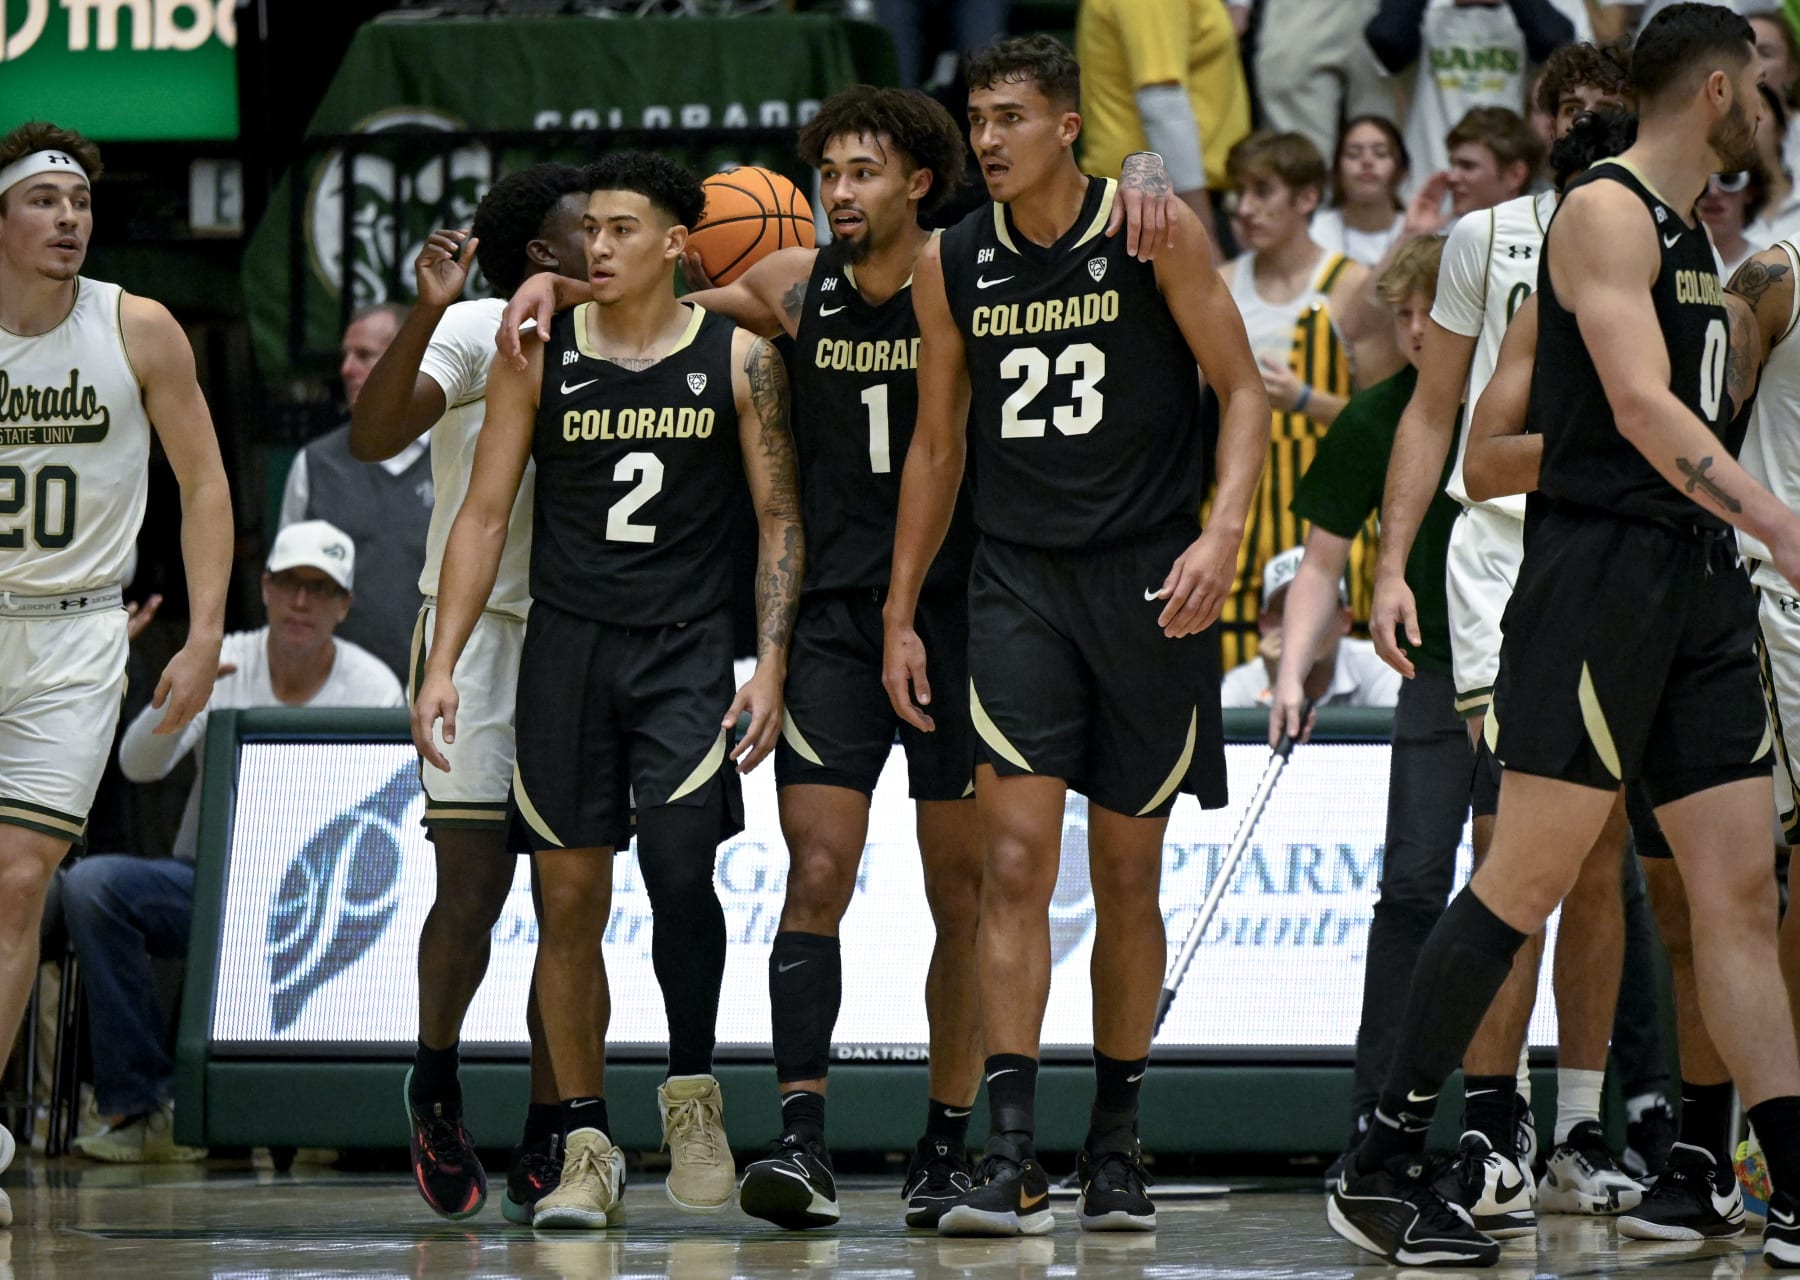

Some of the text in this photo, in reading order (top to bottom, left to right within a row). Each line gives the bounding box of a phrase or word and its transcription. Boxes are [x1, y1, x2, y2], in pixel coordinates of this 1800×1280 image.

[977, 248, 995, 264] BH
[820, 277, 838, 291] BH
[972, 289, 1119, 337] COLORADO
[562, 350, 579, 366] BH
[1700, 319, 1727, 422] 0
[1000, 342, 1105, 439] 23
[43, 427, 75, 443] UNIV
[563, 407, 715, 442] COLORADO
[860, 383, 891, 474] 1
[0, 463, 80, 551] 20
[606, 452, 665, 543] 2
